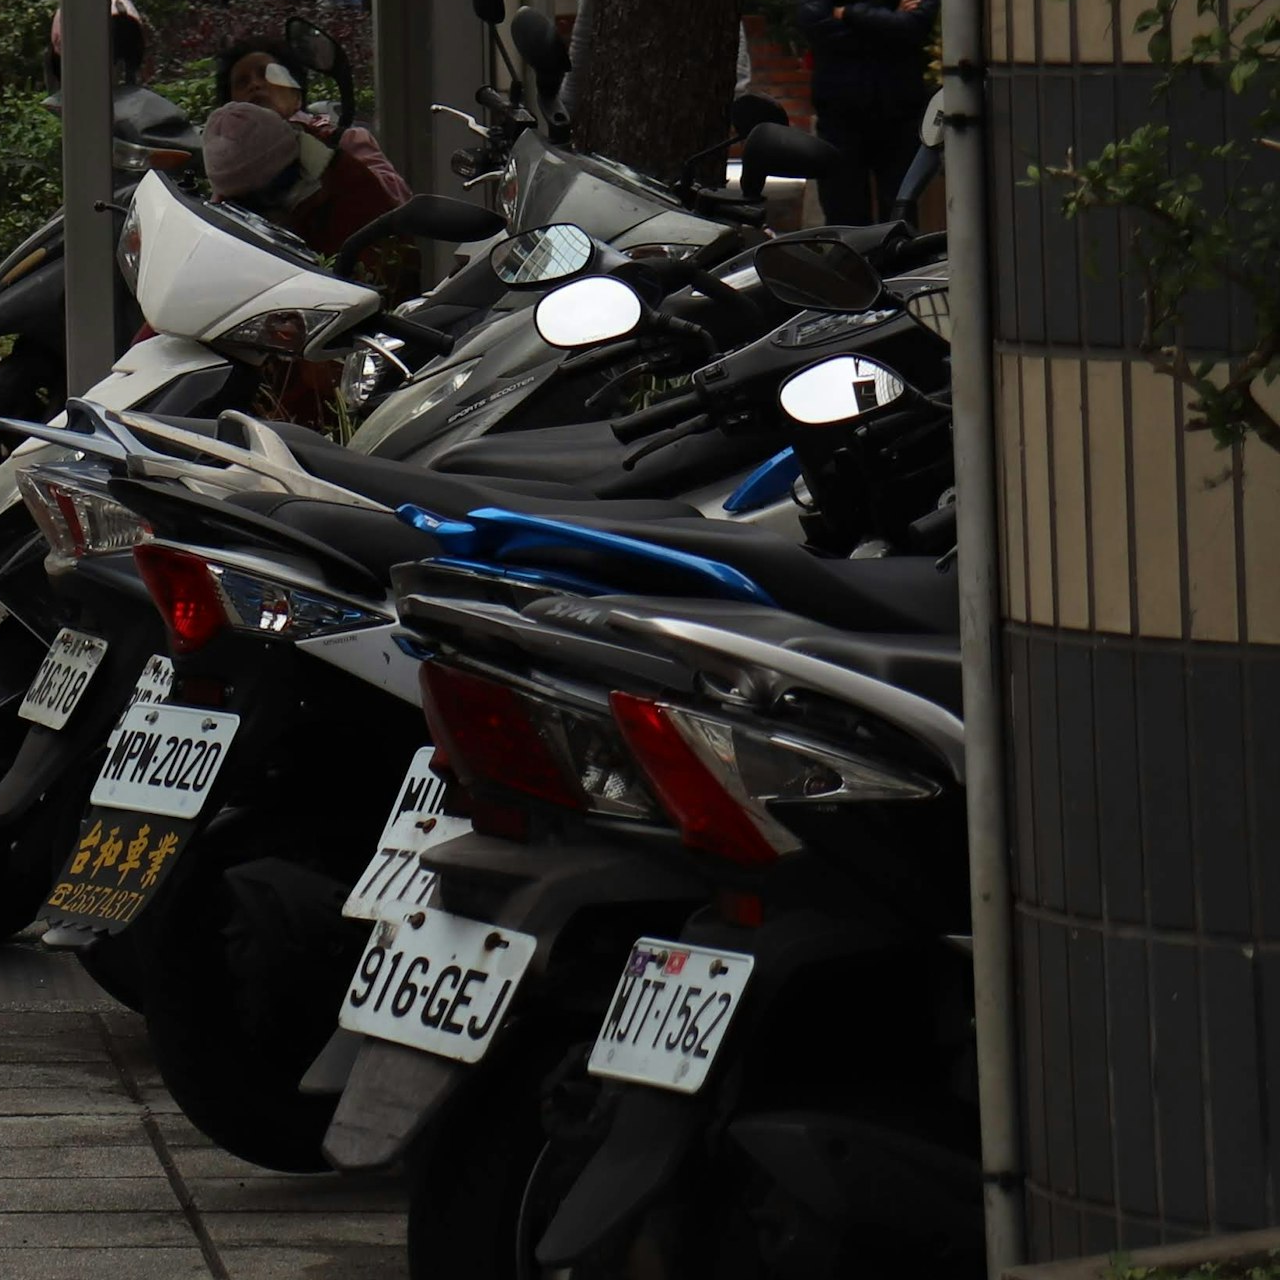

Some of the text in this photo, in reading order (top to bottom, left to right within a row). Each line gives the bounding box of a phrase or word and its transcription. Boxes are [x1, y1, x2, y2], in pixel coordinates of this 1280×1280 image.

[547, 602, 602, 625] SYM
[102, 728, 223, 793] MPM-2020
[69, 819, 180, 890] 台和車業
[349, 944, 513, 1041] 916-GEJ
[601, 974, 733, 1060] MJT-1562
